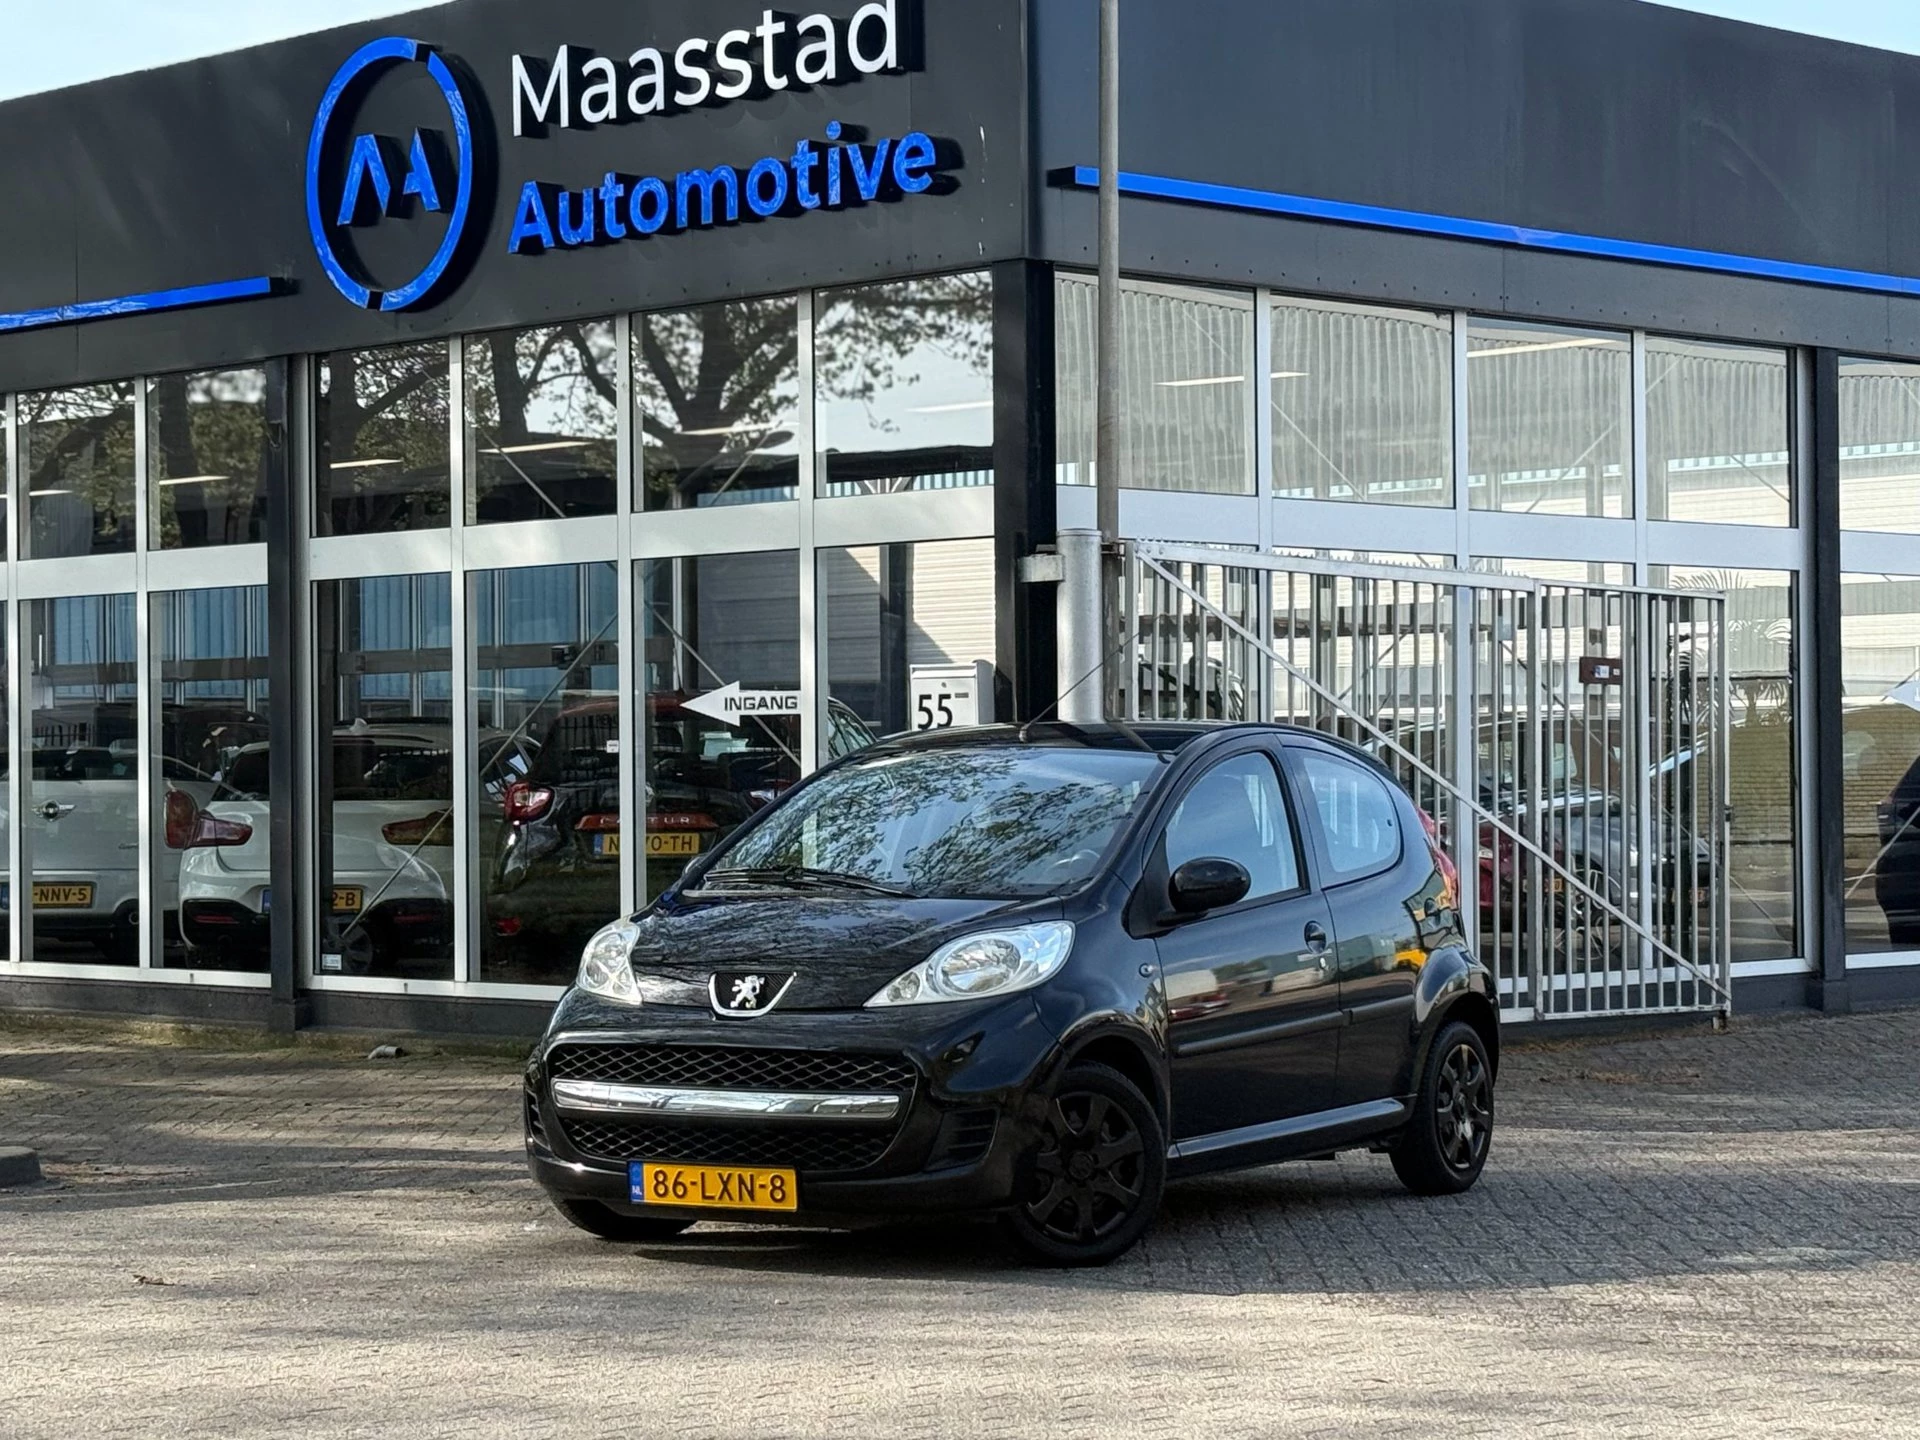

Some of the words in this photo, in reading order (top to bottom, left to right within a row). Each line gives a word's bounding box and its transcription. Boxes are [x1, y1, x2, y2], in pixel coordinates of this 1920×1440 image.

[512, 0, 897, 137] Maasstad
[508, 120, 936, 254] Automotive
[724, 695, 798, 712] INGANG
[917, 693, 953, 730] 55
[33, 887, 87, 902] -NNV-5
[653, 1169, 787, 1204] 86-LXN-8
